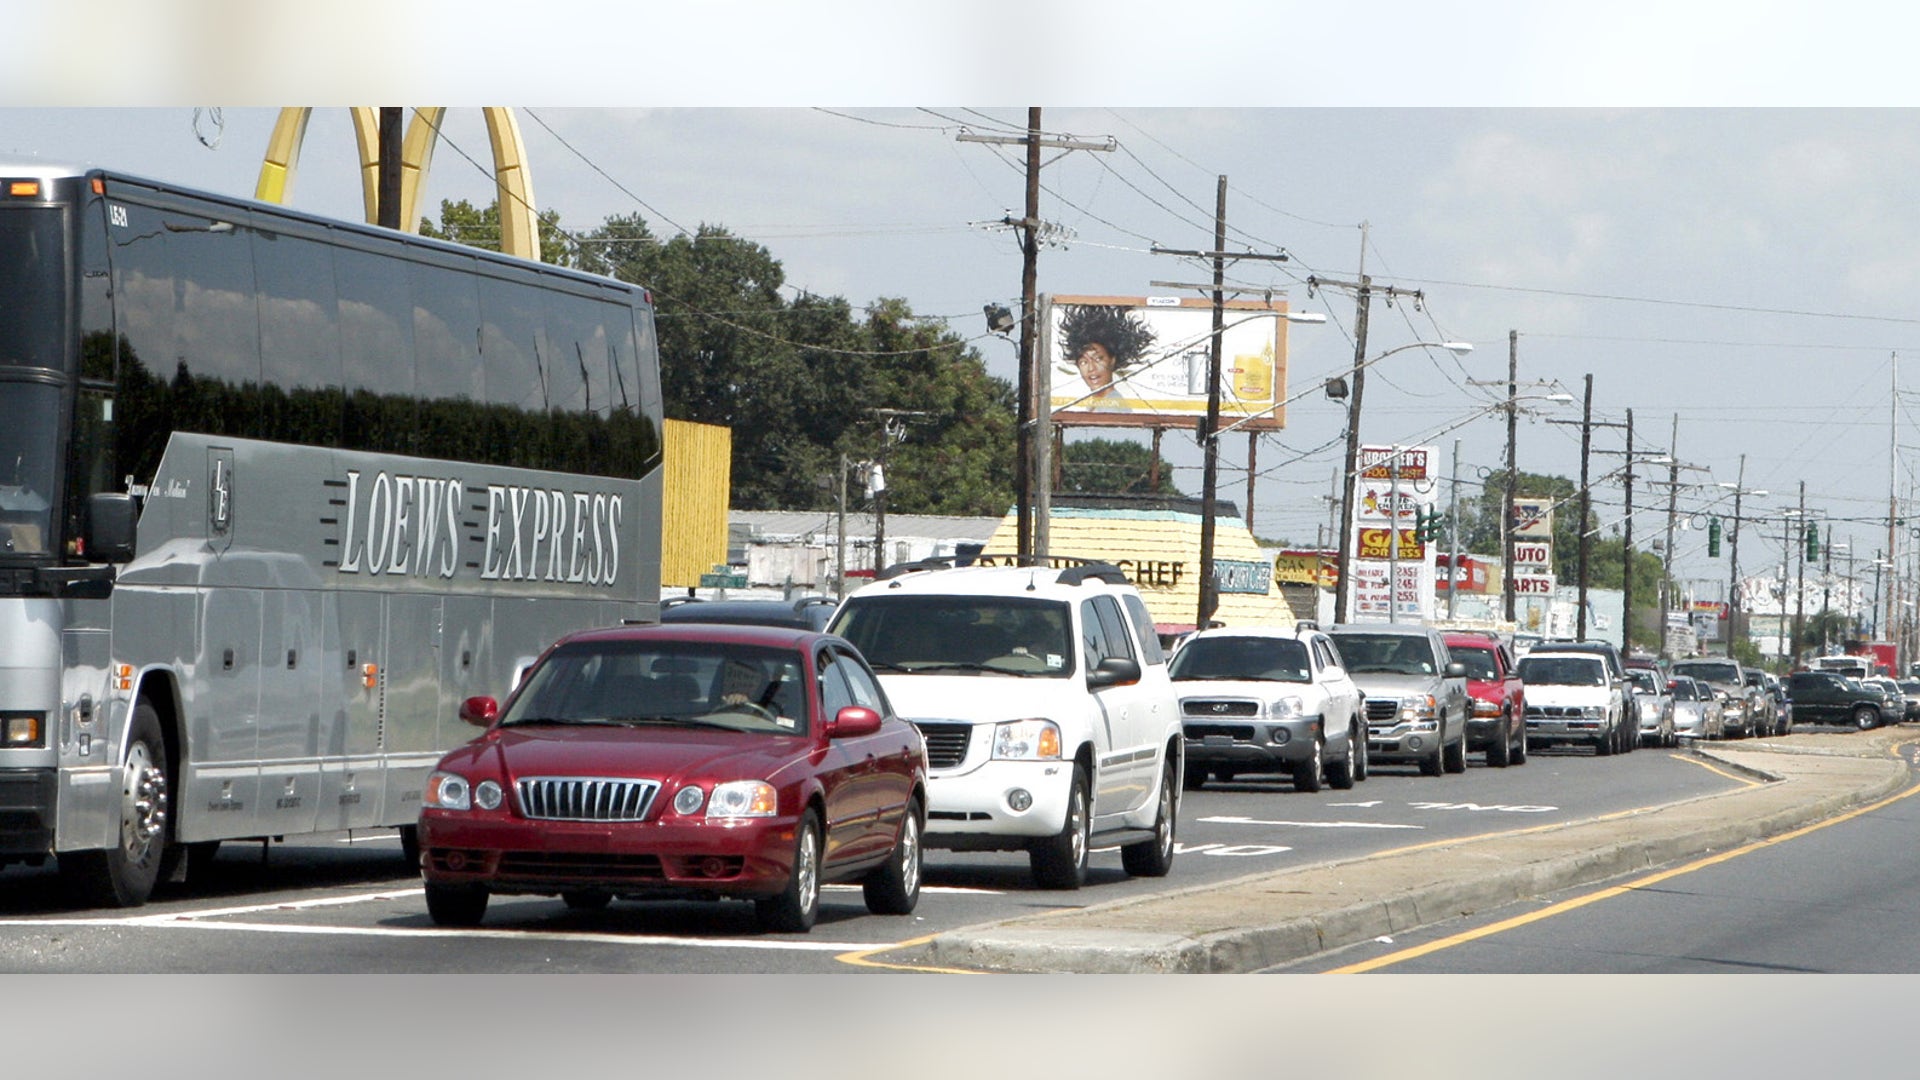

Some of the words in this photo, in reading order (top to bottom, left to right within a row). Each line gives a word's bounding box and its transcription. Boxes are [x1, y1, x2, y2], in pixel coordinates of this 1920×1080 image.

[338, 471, 463, 578] LOEWS
[480, 485, 623, 586] EXPRESS
[1361, 547, 1389, 556] FOR
[1398, 549, 1421, 557] ESS
[1513, 548, 1546, 562] UTO
[1275, 558, 1305, 573] GAS
[1504, 578, 1550, 593] ARTS
